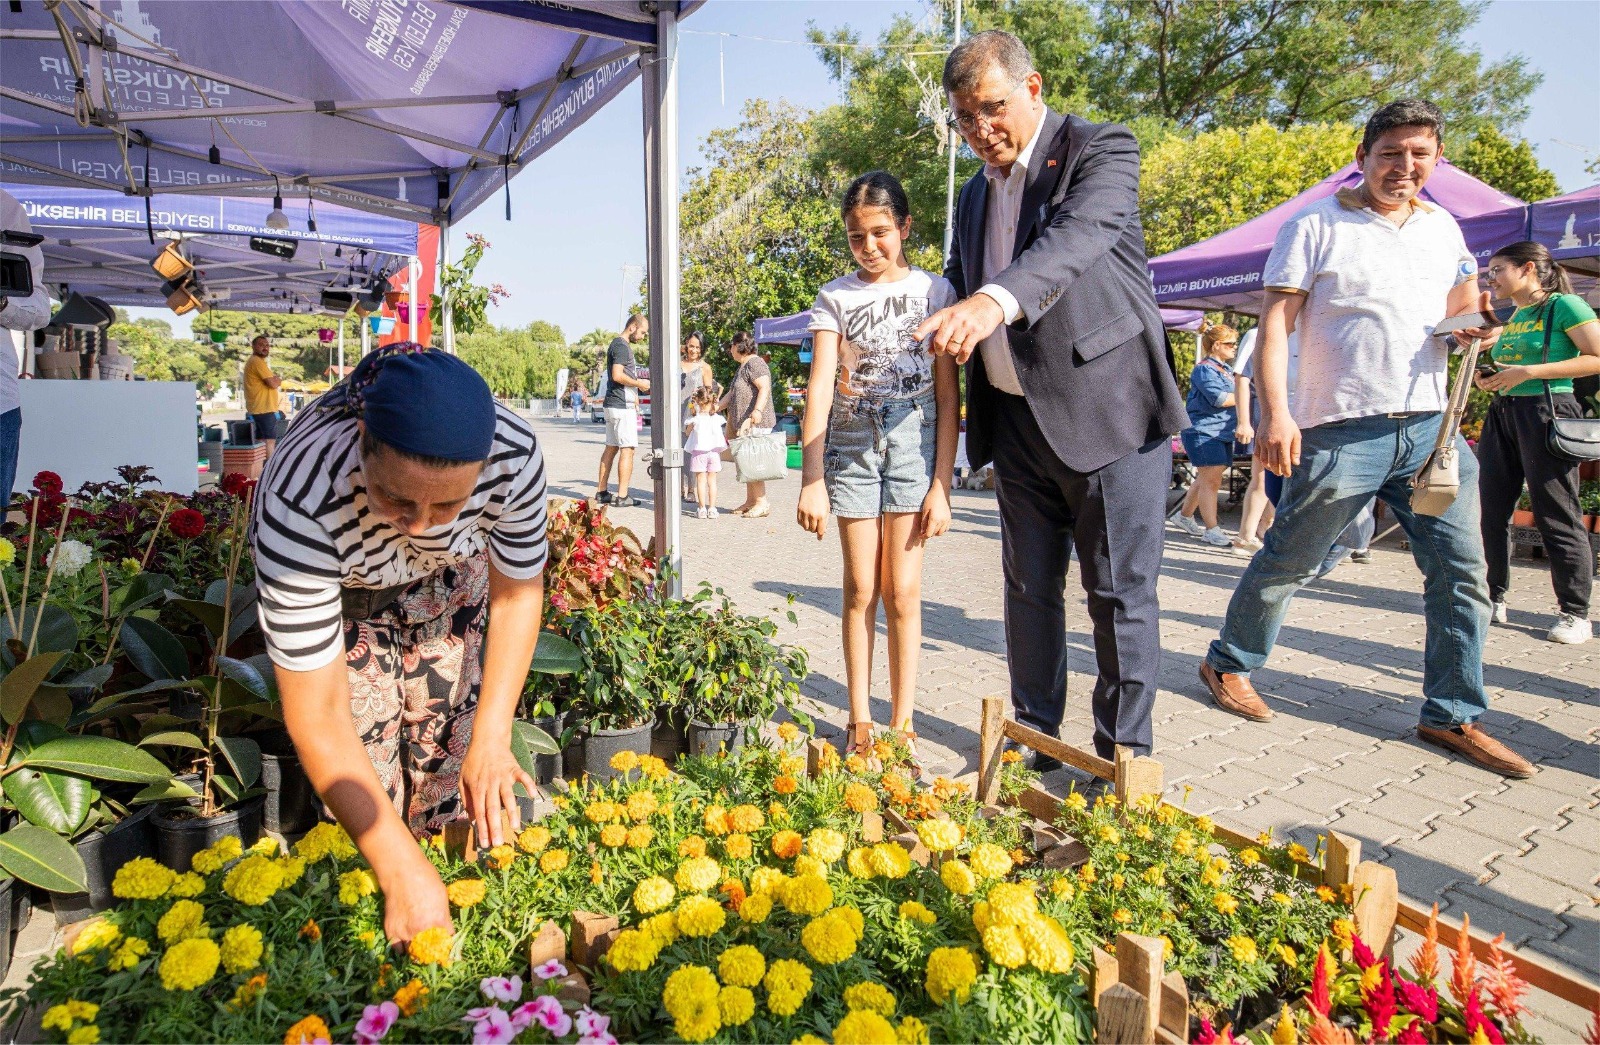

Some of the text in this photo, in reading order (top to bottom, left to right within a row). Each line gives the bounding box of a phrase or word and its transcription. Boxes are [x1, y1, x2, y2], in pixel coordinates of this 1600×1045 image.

[112, 209, 214, 229] BELEDİYESİ
[227, 223, 258, 234] SOSYAL
[1188, 271, 1260, 292] BÜYÜKŞEHİR
